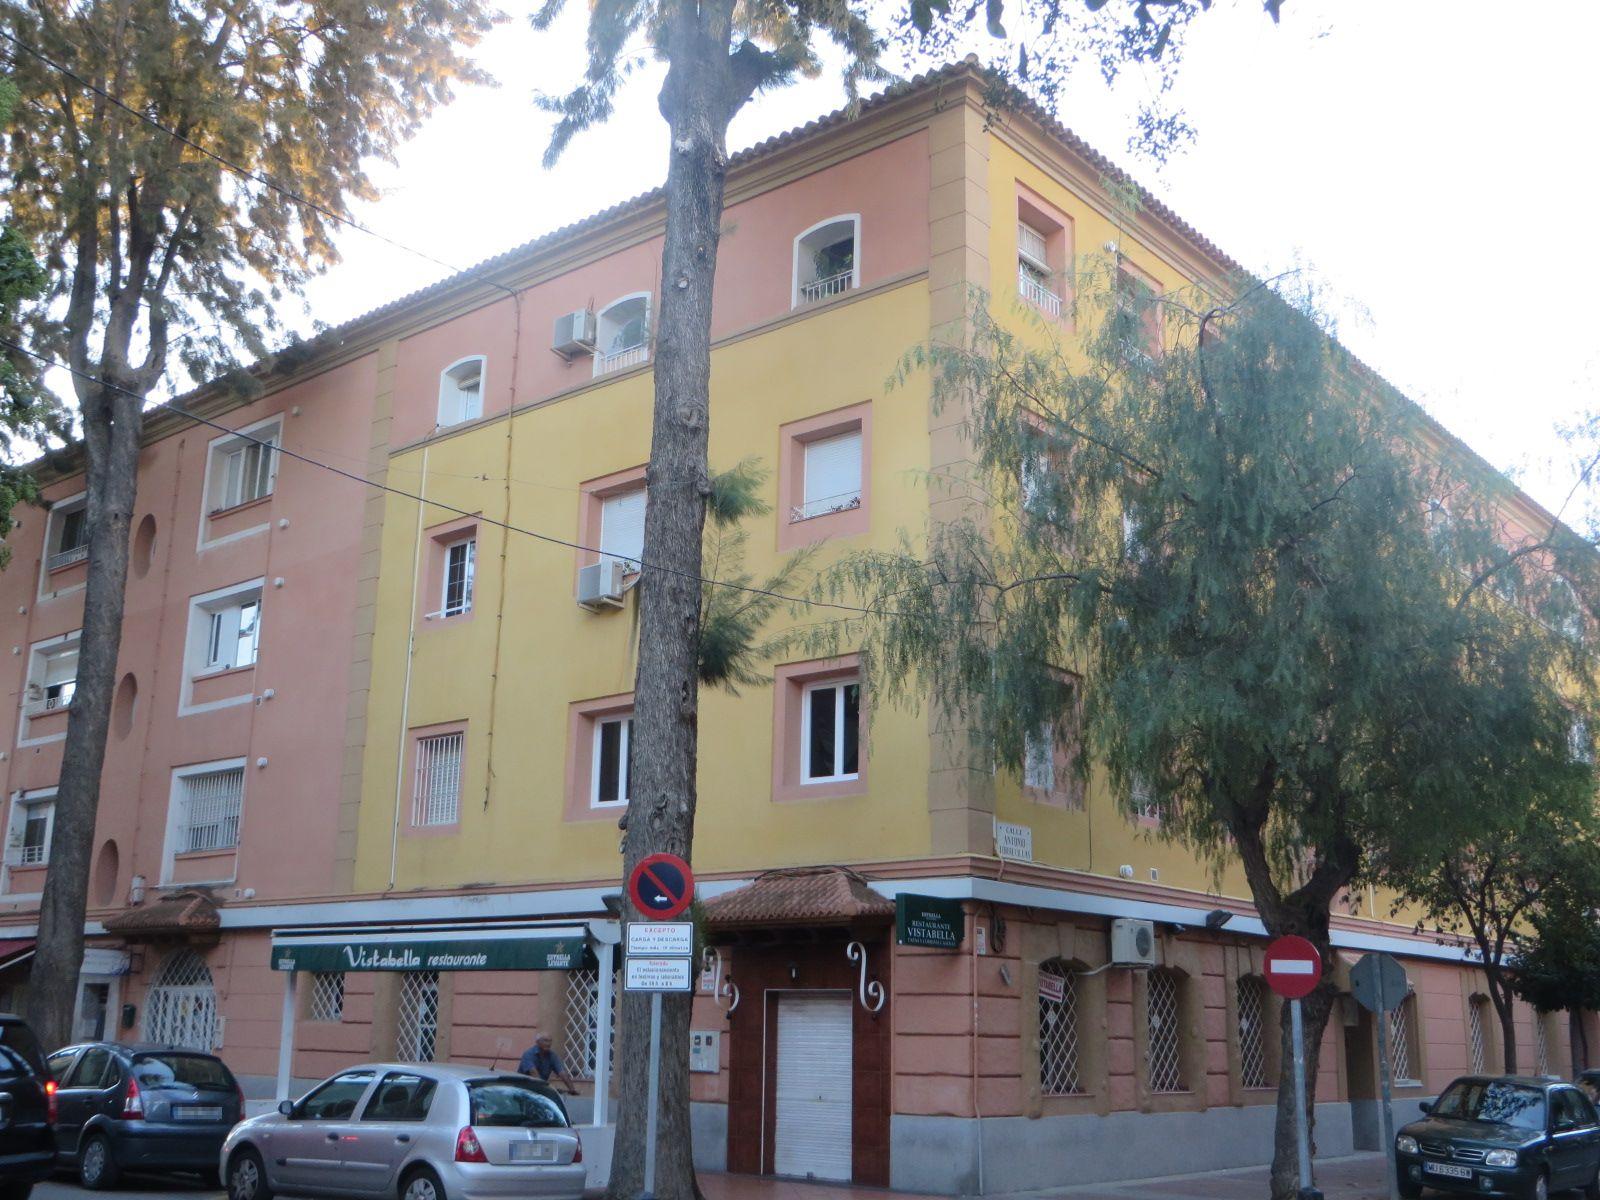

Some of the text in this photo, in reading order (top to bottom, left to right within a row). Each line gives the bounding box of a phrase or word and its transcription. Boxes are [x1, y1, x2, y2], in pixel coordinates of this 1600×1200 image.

[911, 920, 950, 931] RESTAURANTE
[907, 927, 955, 941] VISTABELLA
[343, 945, 488, 968] Vistabella restaurante
